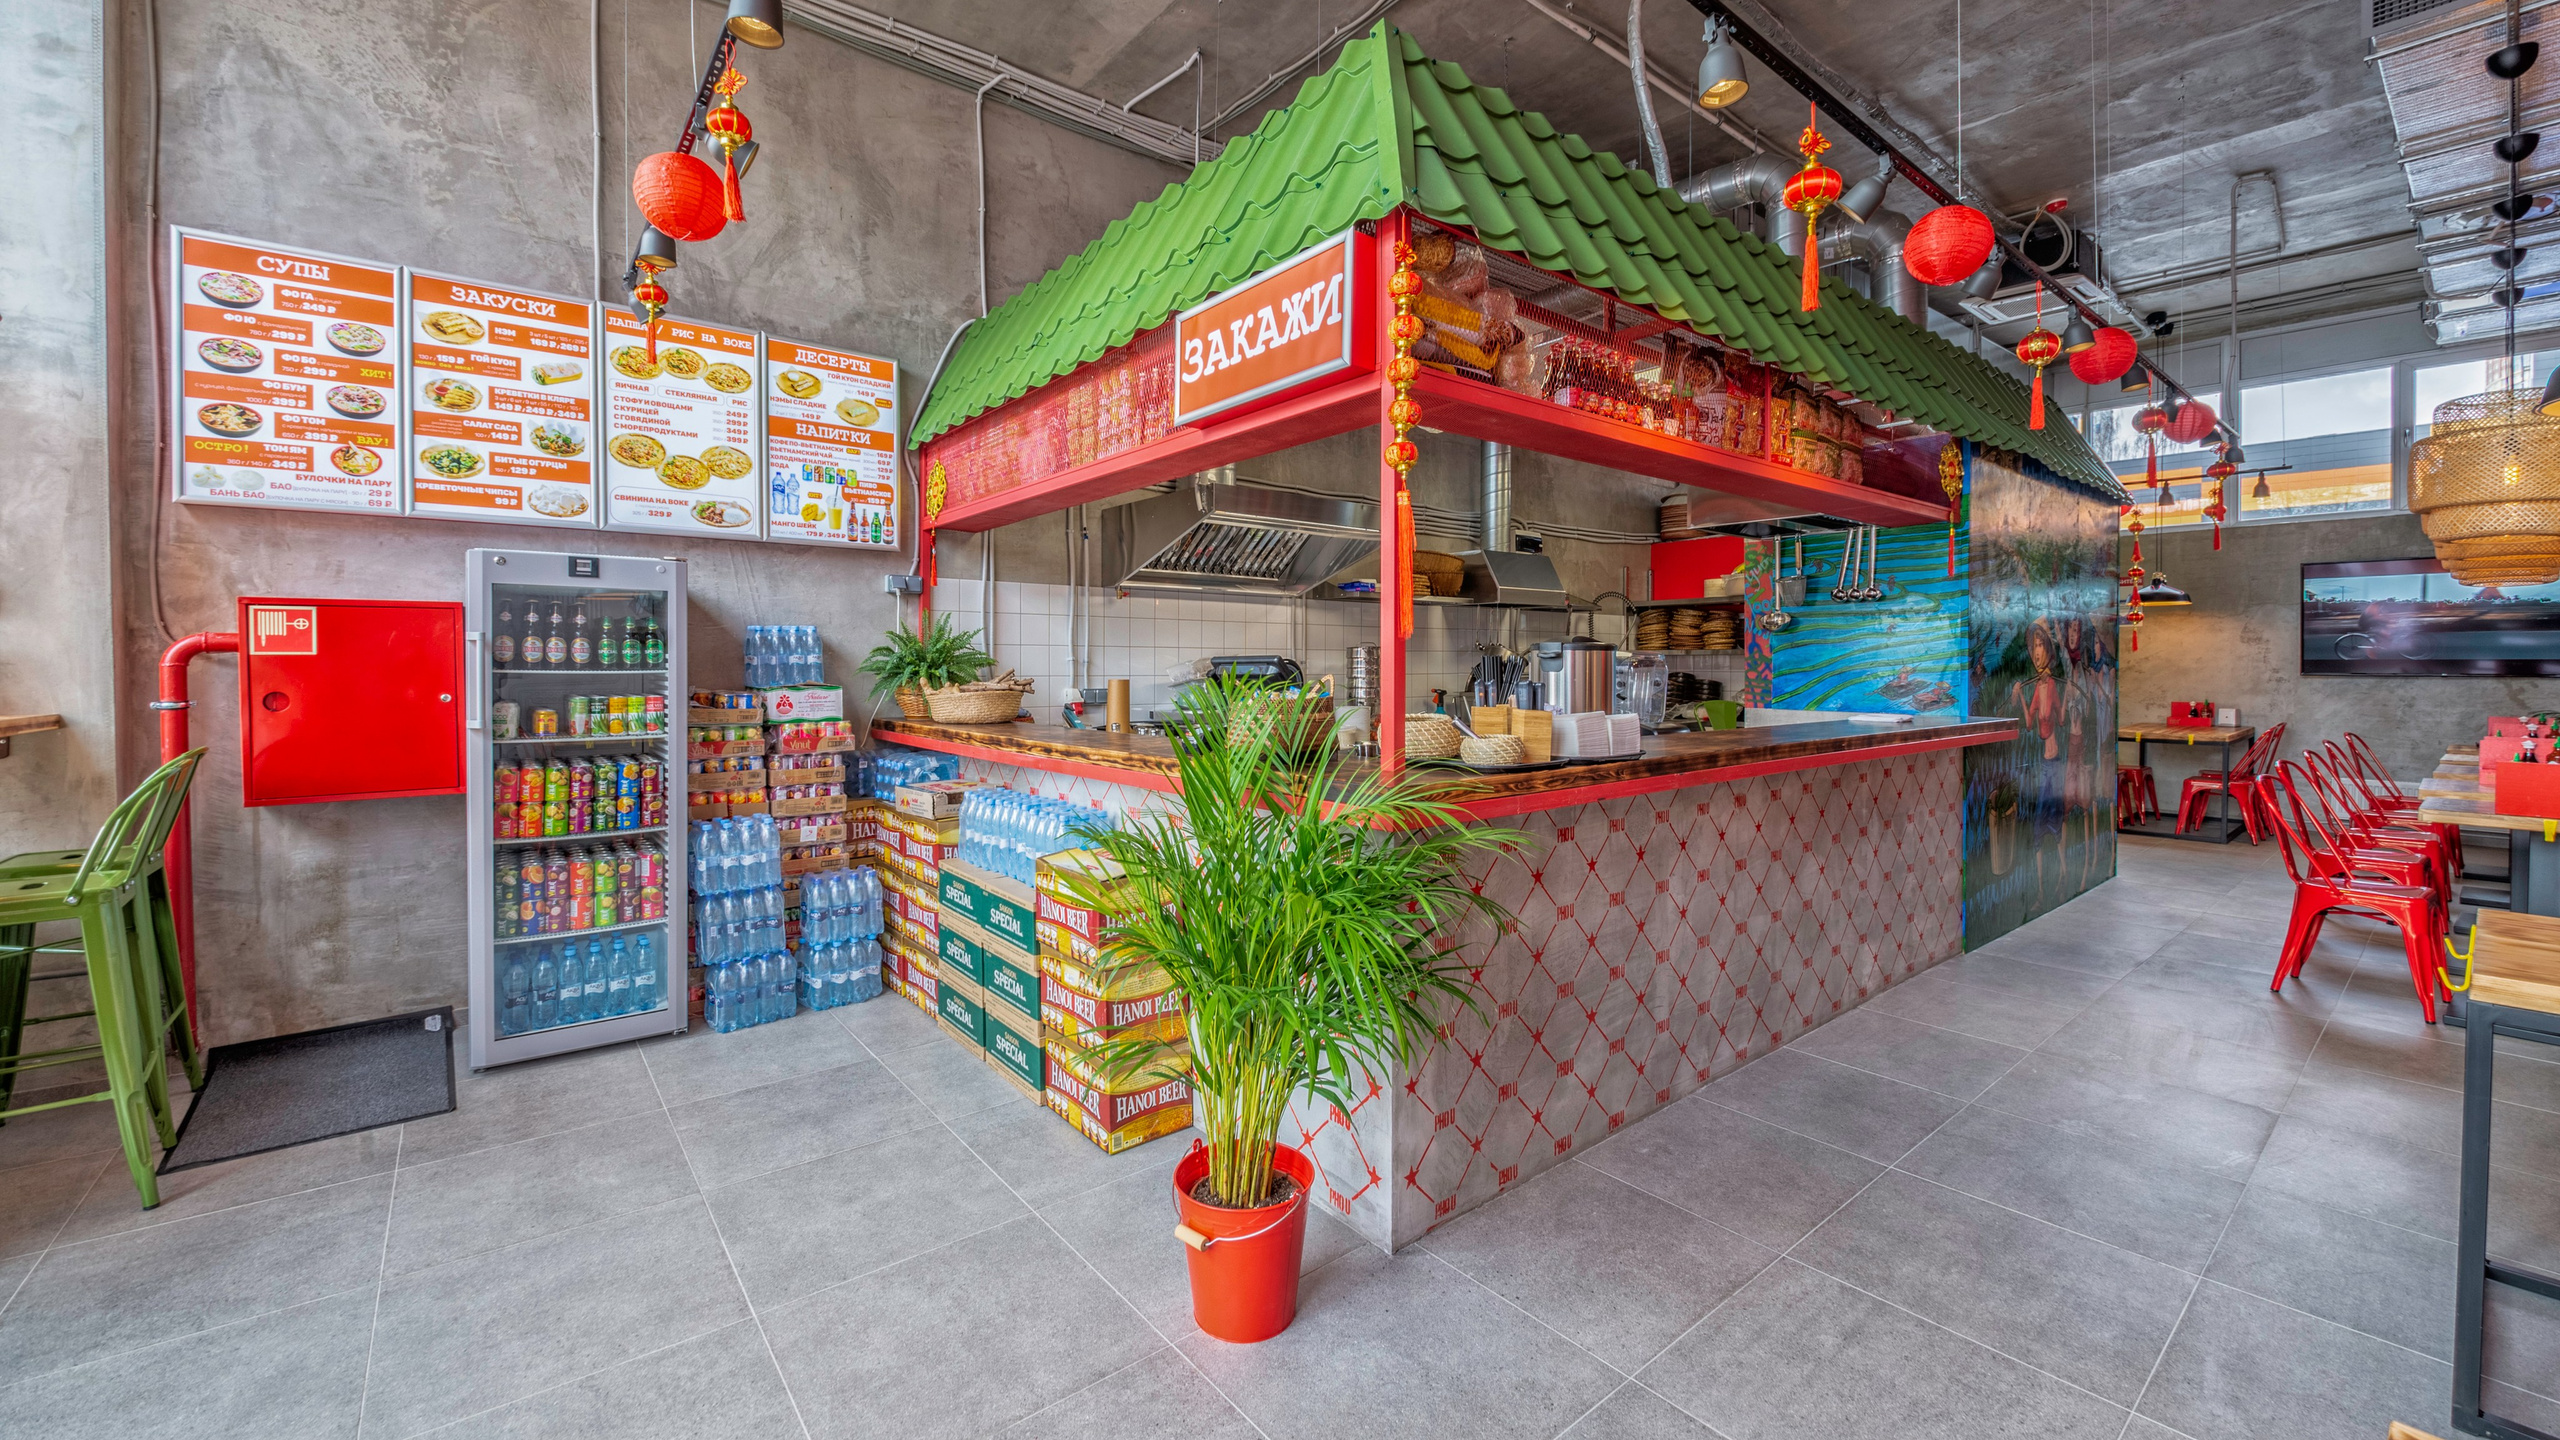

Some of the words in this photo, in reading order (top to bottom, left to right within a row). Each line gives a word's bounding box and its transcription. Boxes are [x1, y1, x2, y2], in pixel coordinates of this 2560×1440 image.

[257, 255, 330, 281] СУПЫ
[281, 289, 299, 298] ФО
[300, 291, 314, 301] ГА
[450, 285, 556, 318] ЗАКУСКИ
[223, 313, 242, 323] ФО
[243, 315, 256, 325] Ю
[494, 327, 516, 337] НЭМ
[1182, 273, 1343, 383] ЗАКАЖИ
[672, 328, 695, 339] РИС
[701, 334, 717, 343] НА
[723, 337, 752, 349] ВОКЕ
[281, 353, 299, 363] ФО
[470, 353, 490, 363] ГОЙ
[491, 356, 517, 367] КУОН
[795, 349, 871, 373] ДЕСЕРТЫ
[262, 380, 281, 389] ФО
[282, 382, 307, 393] БУМ
[615, 382, 649, 392] ЯИЧНАЯ
[828, 372, 840, 380] ГОЙ
[841, 375, 859, 383] КУОН
[859, 378, 891, 389] СЛАДКИЙ
[494, 388, 540, 400] КРЕВЕТКИ
[547, 395, 575, 404] КЛЯРЕ
[665, 389, 717, 402] СТЕКЛЯННАЯ
[770, 396, 793, 404] НЭМЫ
[793, 399, 827, 409] СЛАДКИЕ
[620, 397, 643, 405] ТОФУ
[651, 400, 693, 412] ОВОЩАМИ
[620, 405, 659, 416] КУРИЦЕЙ
[281, 414, 300, 423] ФО
[301, 416, 326, 425] ТОМ
[463, 420, 493, 430] САЛАТ
[494, 423, 518, 432] САСА
[620, 413, 671, 426] ГОВЯДИНОЙ
[620, 424, 698, 438] МОРЕПРОДУКТАМИ
[796, 423, 871, 445] НАПИТКИ
[263, 443, 287, 453] ТОМ
[288, 445, 307, 454] ЯМ
[770, 438, 789, 446] КОФЕ
[770, 446, 819, 457] ВЬЕТНАМСКИЙ
[494, 456, 528, 465] БИТЫЕ
[529, 459, 567, 469] ОГУРЦЫ
[770, 454, 808, 464] ХОЛОДНЫЕ
[809, 459, 839, 467] НАПИТКИ
[270, 482, 292, 490] БАО
[296, 474, 346, 485] БУЛОЧКИ
[348, 478, 362, 486] НА
[364, 479, 392, 488] ПАРУ
[210, 489, 240, 498] БАНЬ
[243, 491, 265, 499] БАО
[416, 482, 484, 494] КРЕВЕТОЧНЫЕ
[485, 488, 518, 497] ЧИПСЫ
[614, 494, 654, 503] СВИНИНА
[771, 520, 796, 528] МАНГО
[906, 836, 921, 857] HANOI
[921, 845, 934, 866] BEER
[946, 885, 974, 910] SPECIAL
[907, 900, 923, 922] HANOI
[923, 910, 936, 933] BEER
[1040, 892, 1066, 924] HANOI
[1067, 907, 1089, 938] BEER
[990, 908, 1023, 937] SPECIAL
[946, 941, 974, 970] SPECIAL
[907, 962, 923, 987] HANOI
[923, 976, 936, 1000] BEER
[994, 969, 1026, 1002] SPECIAL
[1046, 975, 1072, 1009] HANOI
[1074, 994, 1097, 1028] BEER
[946, 998, 974, 1030] SPECIAL
[1113, 1000, 1152, 1027] HANOI
[996, 1034, 1029, 1071] SPECIAL
[1051, 1061, 1078, 1098] HANOI
[1116, 1088, 1157, 1123] HANOI
[1158, 1077, 1188, 1107] BEER
